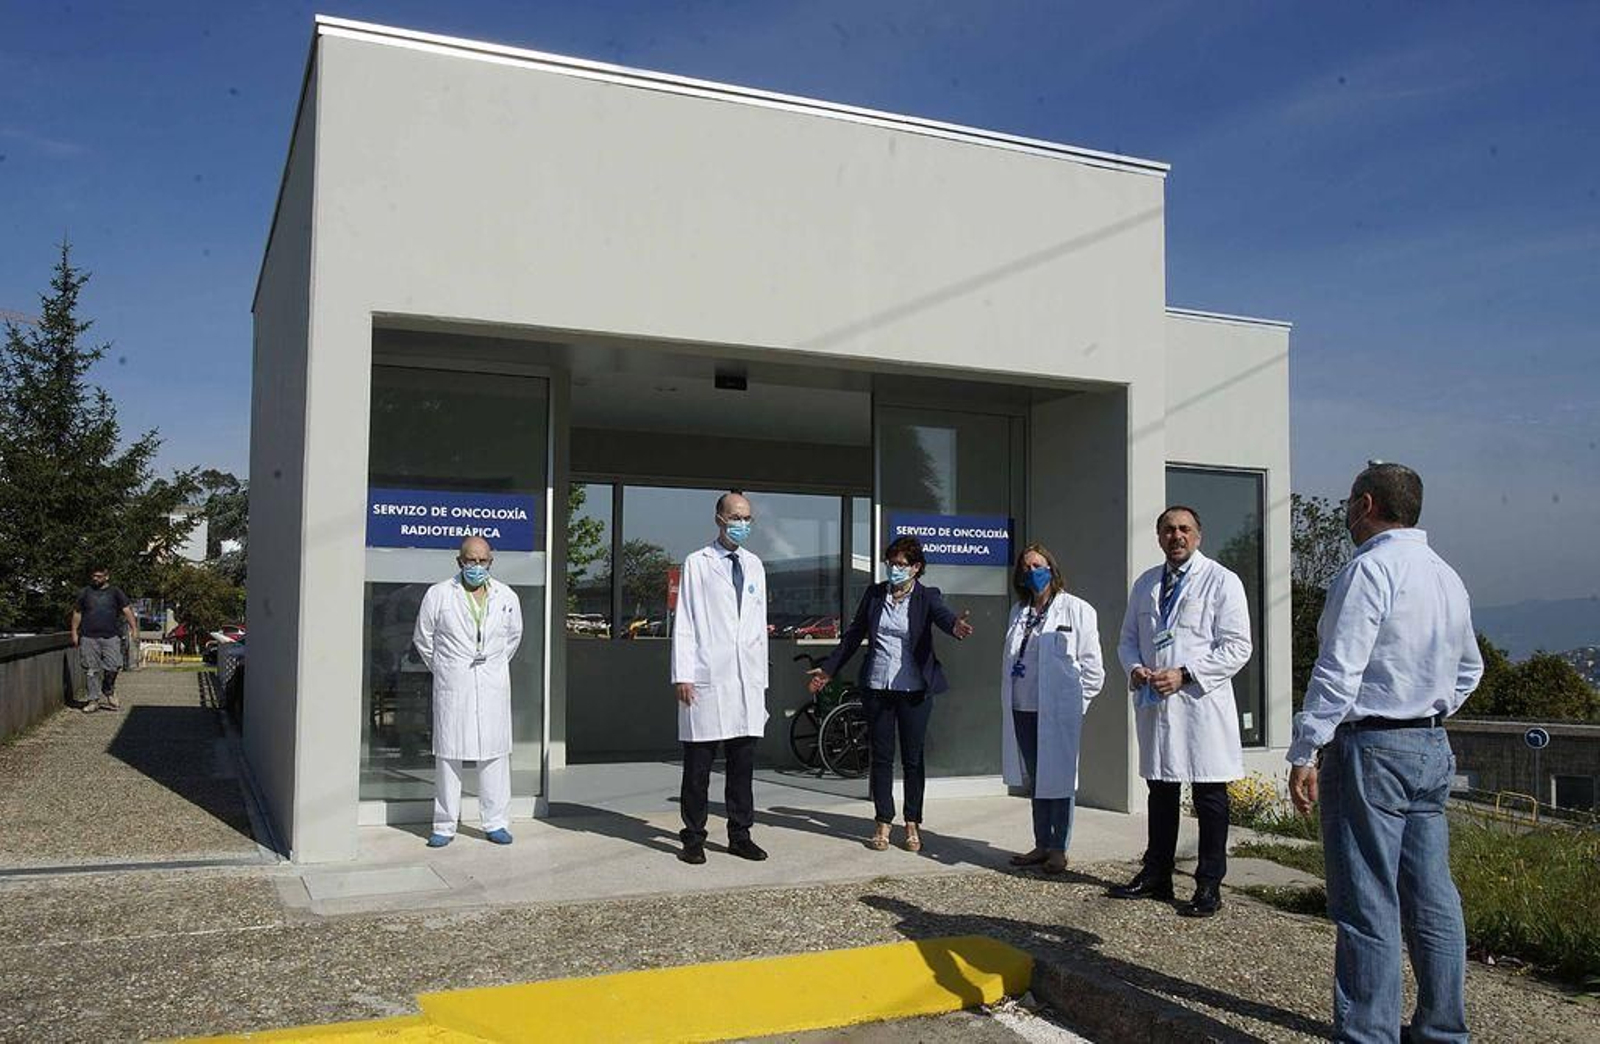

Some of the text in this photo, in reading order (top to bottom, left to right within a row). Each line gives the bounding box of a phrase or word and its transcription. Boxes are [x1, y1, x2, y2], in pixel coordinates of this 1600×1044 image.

[372, 503, 528, 520] SERVIZO DE ONCOLOXÍA
[401, 524, 501, 539] RADIOTERÁPICA
[896, 526, 1009, 539] SERVIZO DE ONCOLOXÍA
[921, 542, 990, 555] ADIOTERÁPICA
